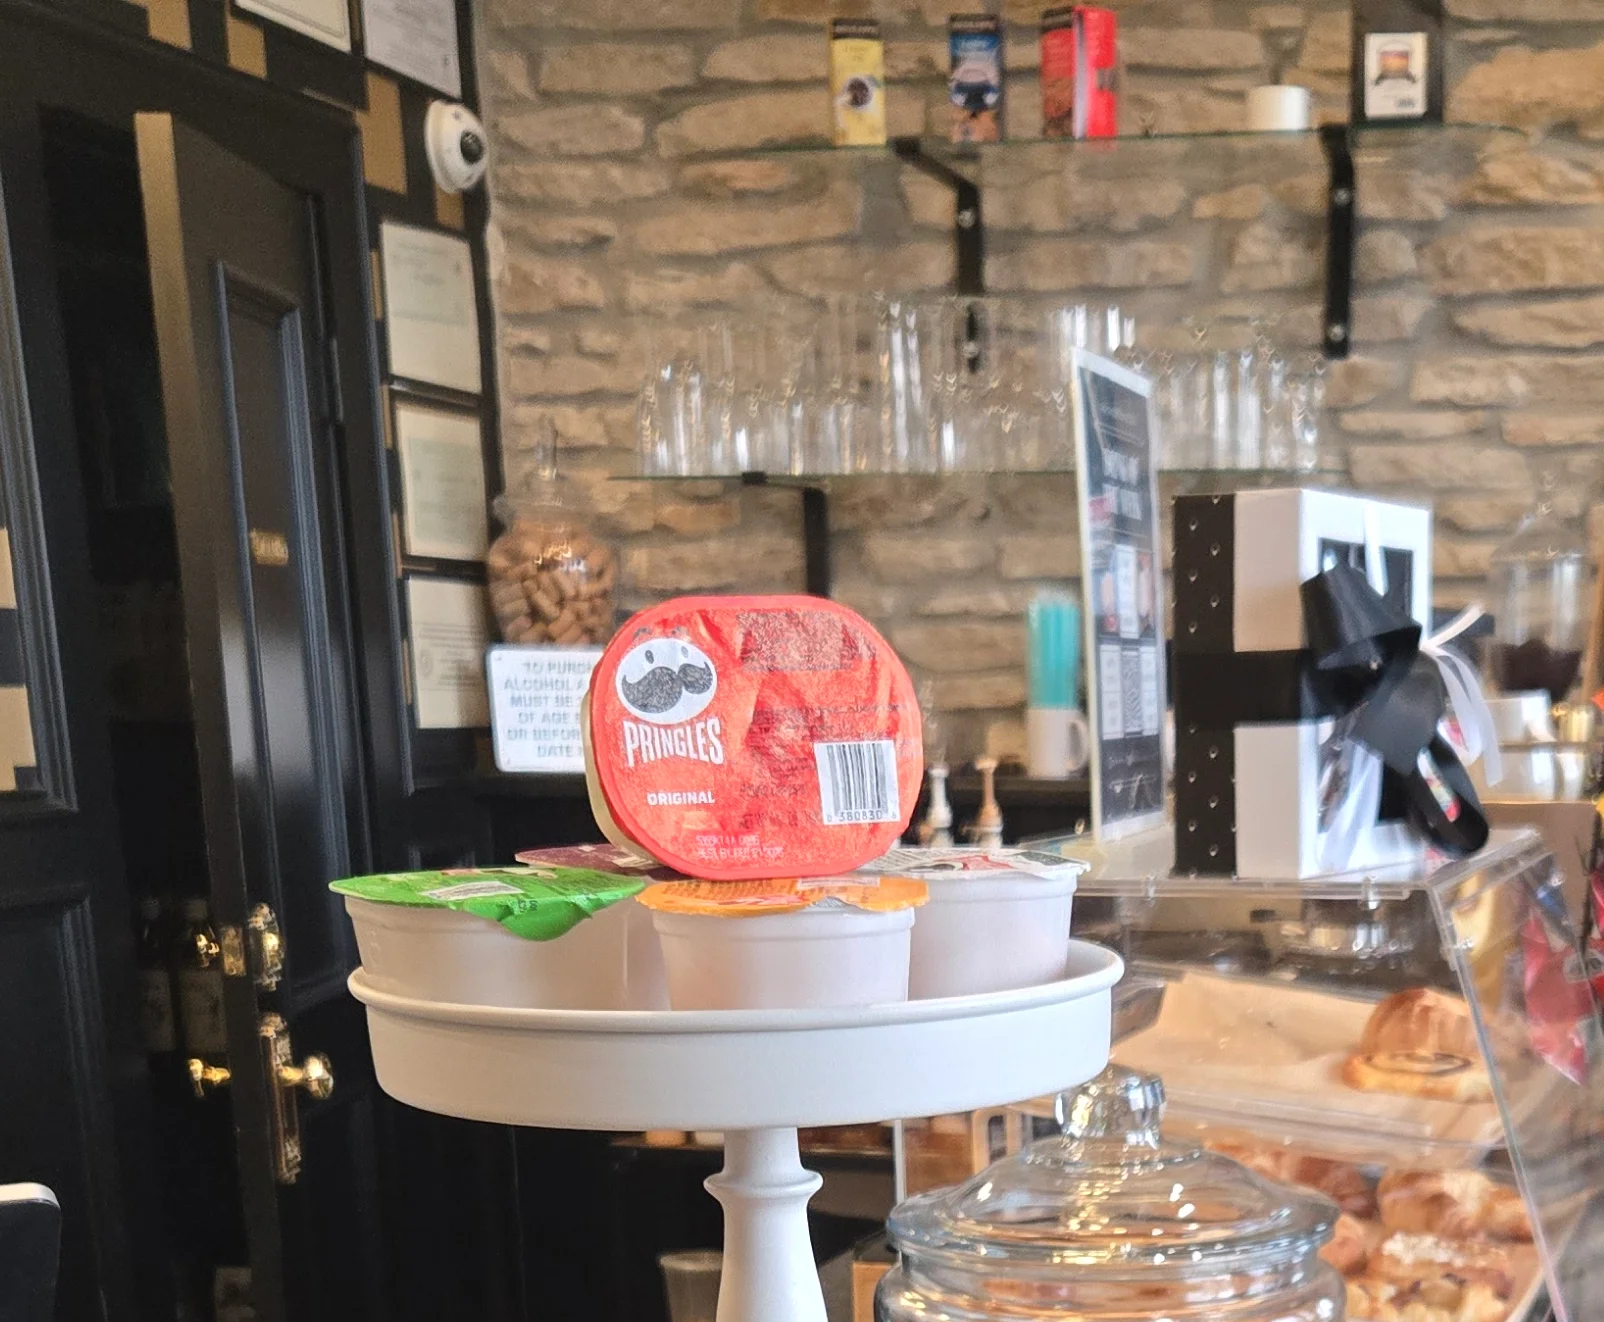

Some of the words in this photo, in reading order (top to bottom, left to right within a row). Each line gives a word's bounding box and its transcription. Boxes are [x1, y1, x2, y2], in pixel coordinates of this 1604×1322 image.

[504, 678, 573, 690] ALCOHOL
[509, 695, 549, 707] MUST
[541, 713, 568, 724] AGE
[533, 729, 581, 741] BEFOR
[622, 716, 725, 769] PRINGLES
[537, 745, 574, 757] DATE
[646, 790, 715, 806] ORIGINAL
